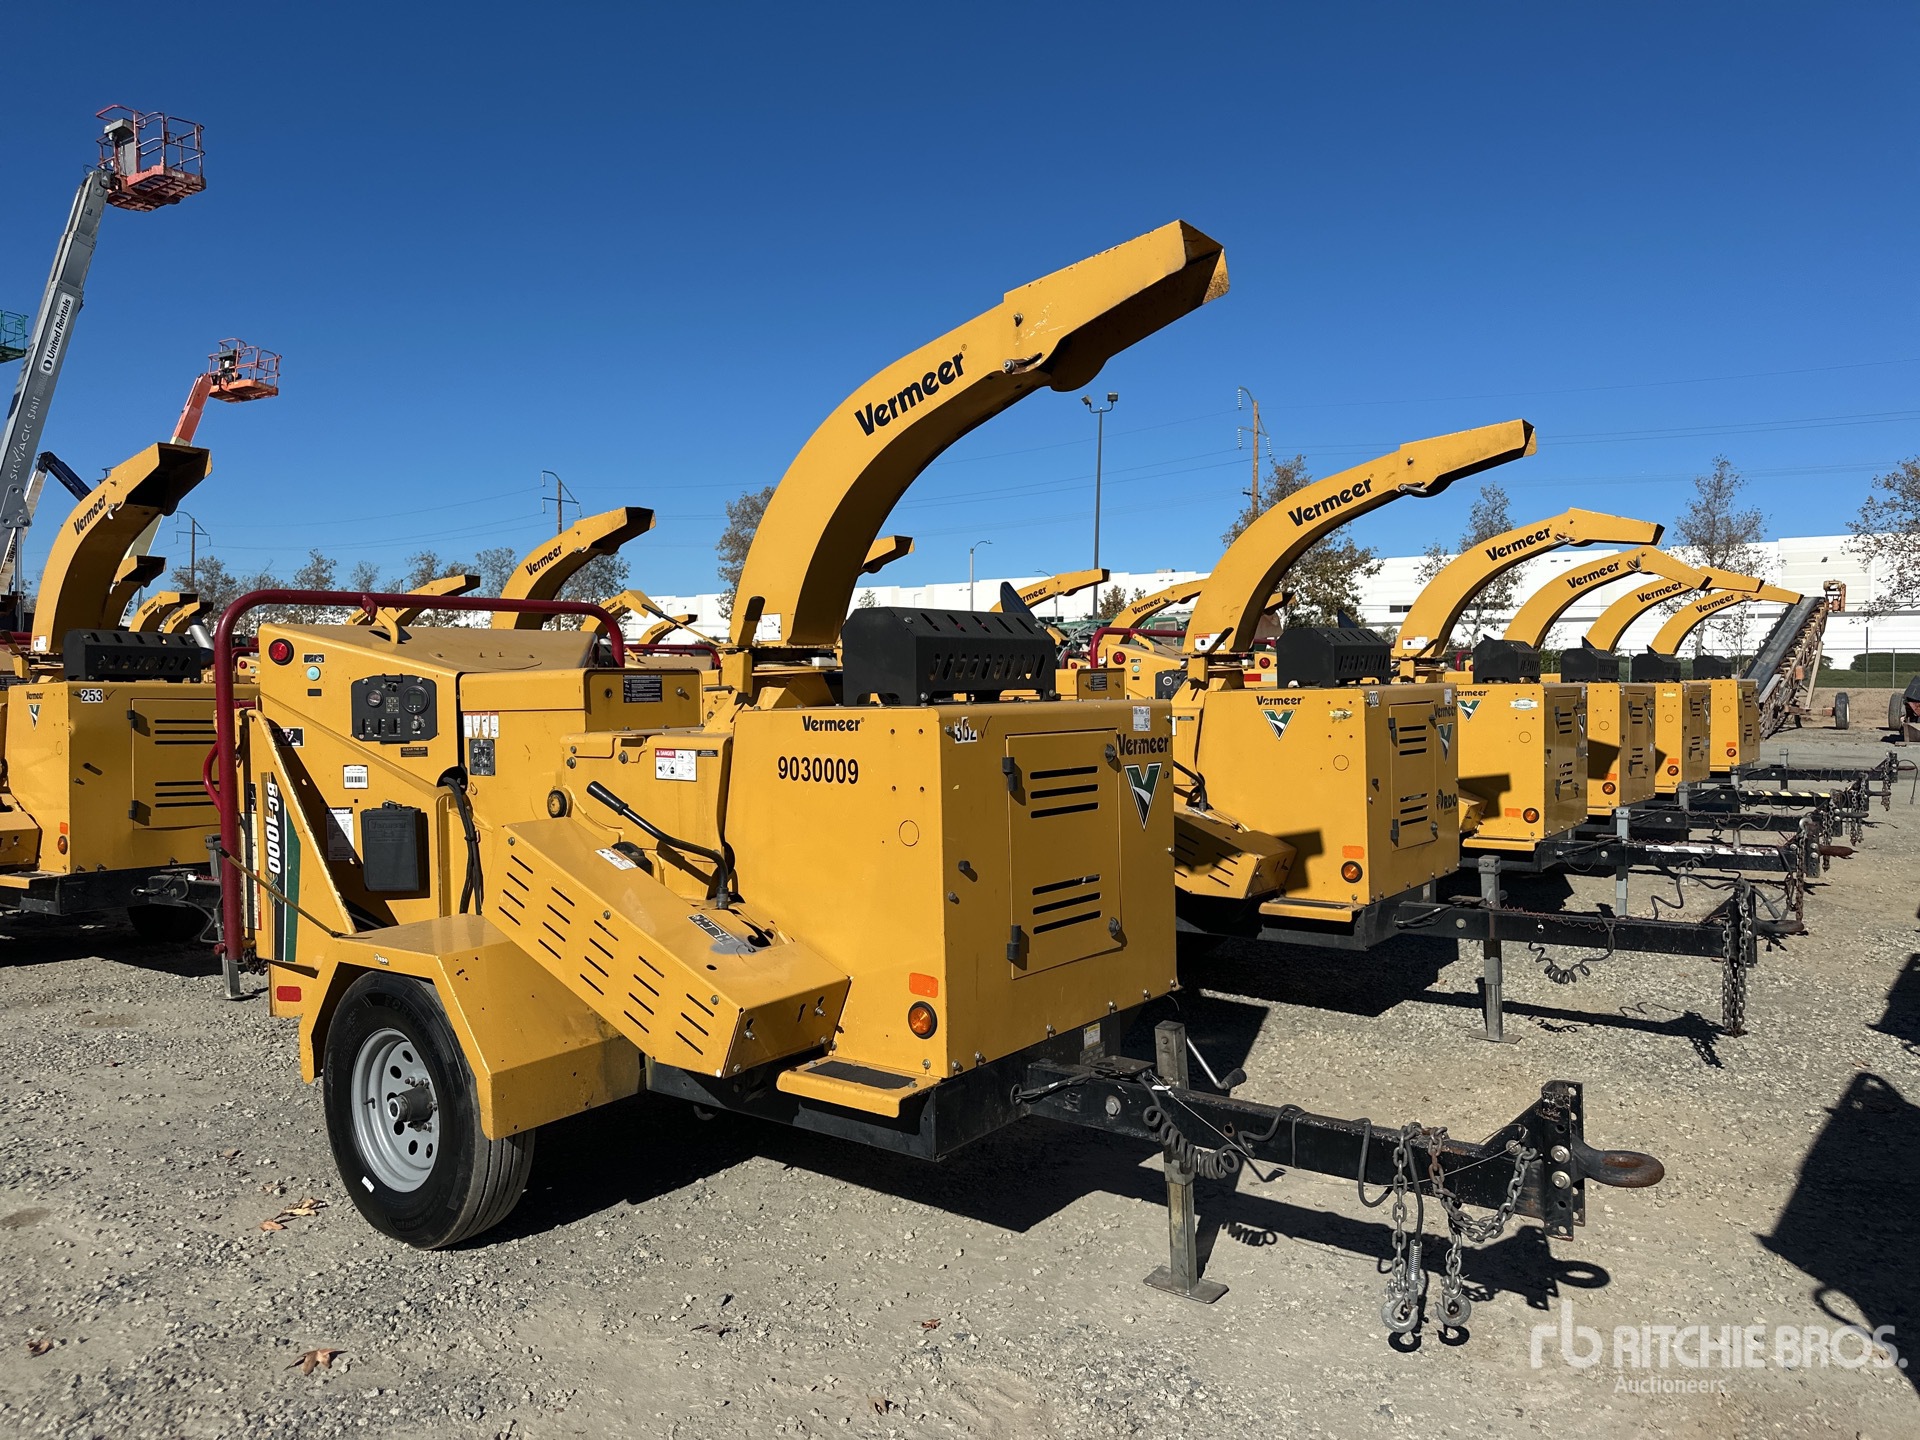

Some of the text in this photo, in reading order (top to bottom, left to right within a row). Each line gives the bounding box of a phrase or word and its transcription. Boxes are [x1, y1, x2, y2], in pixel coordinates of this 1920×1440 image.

[46, 298, 71, 360] United Rentals
[853, 351, 964, 437] Vermeer
[1287, 478, 1372, 527] Vermeer
[73, 494, 107, 536] Vermeer
[1485, 527, 1551, 562] Vermeer
[525, 544, 563, 577] Vermeer
[1566, 561, 1620, 589] Vermeer
[1022, 586, 1048, 603] rmeer
[1636, 581, 1683, 603] Vermeer
[1695, 593, 1735, 613] Vermeer
[1131, 598, 1162, 615] Vermeer
[81, 689, 103, 702] 253
[1256, 695, 1302, 706] Vermeer
[1456, 689, 1488, 697] ermeer
[801, 715, 861, 732] Vermeer
[1116, 733, 1170, 756] Vermeer
[777, 755, 859, 785] 9030009
